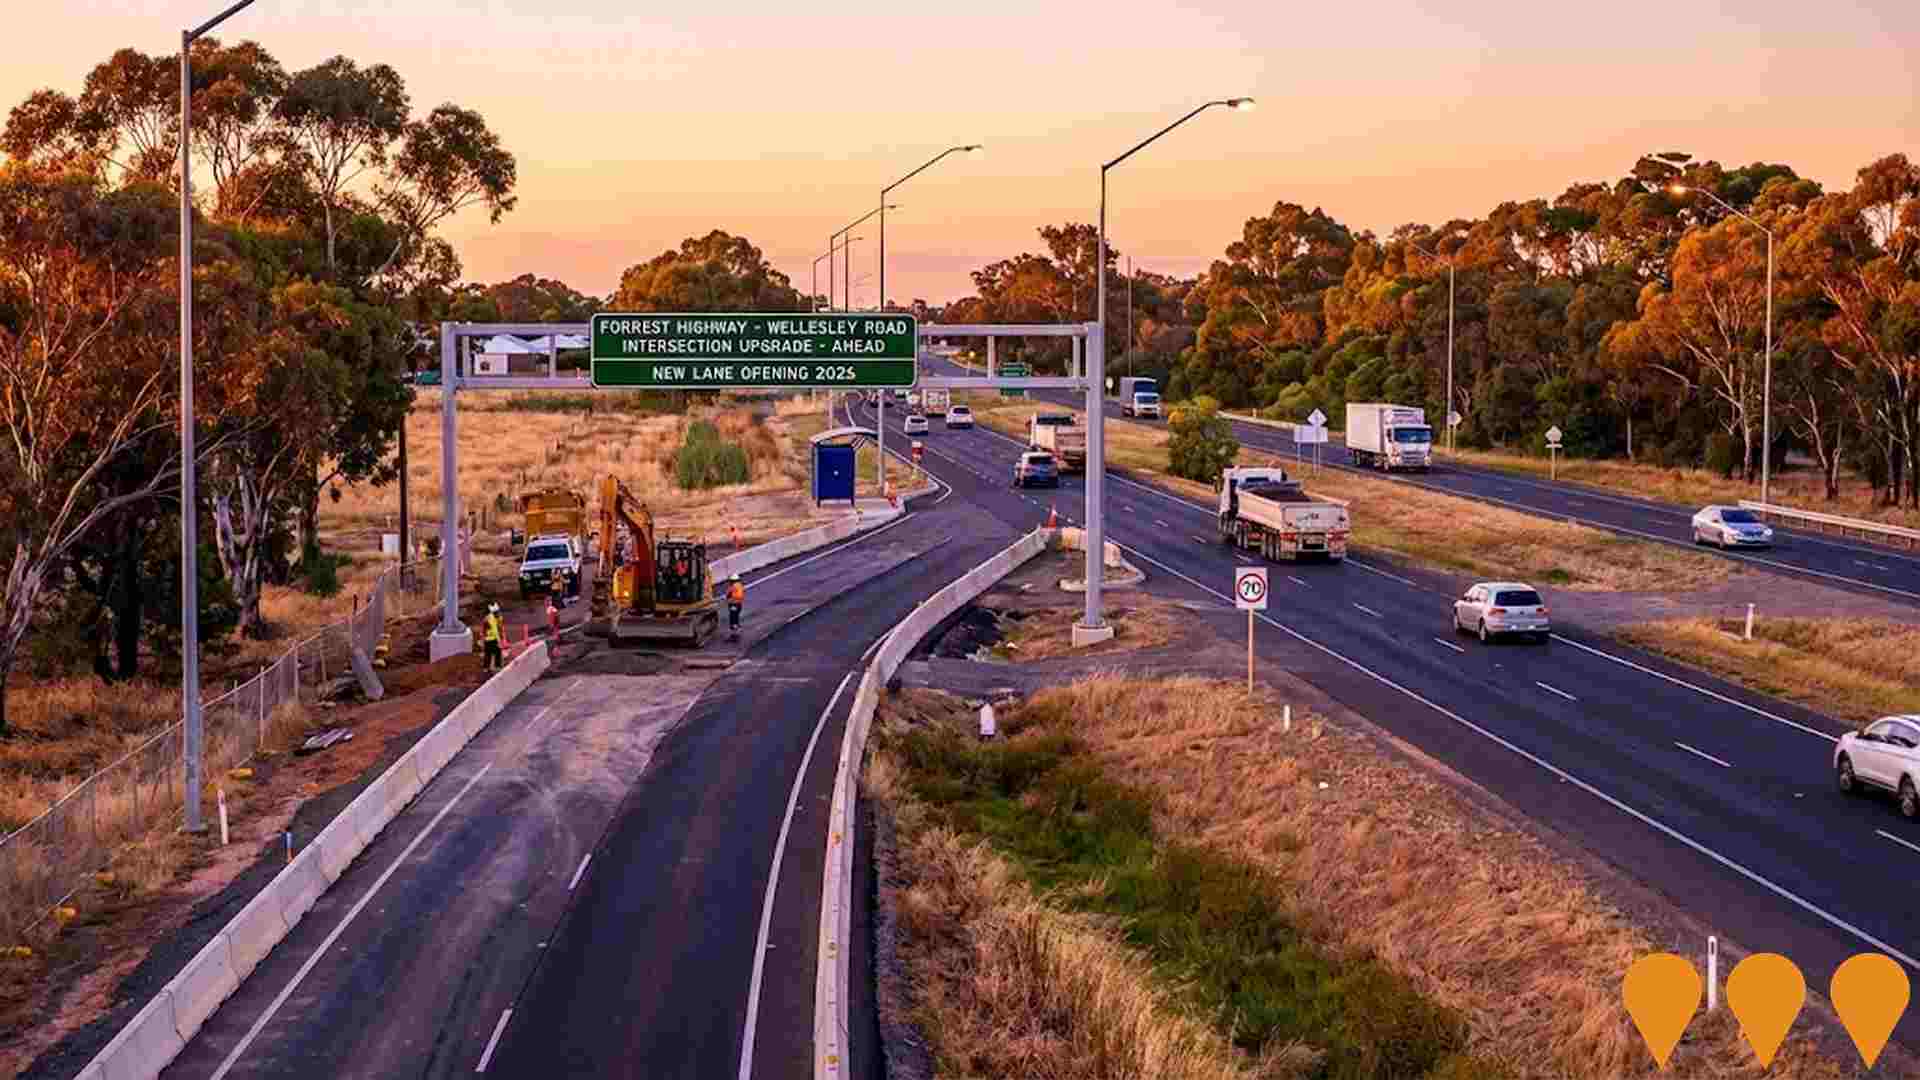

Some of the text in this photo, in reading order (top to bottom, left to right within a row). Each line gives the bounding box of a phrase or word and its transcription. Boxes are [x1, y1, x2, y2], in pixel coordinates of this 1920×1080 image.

[600, 320, 669, 334] FORREST
[676, 320, 747, 334] HIGHWAY
[767, 320, 857, 334] WELLESLEY
[865, 320, 907, 334] ROAD
[622, 339, 732, 353] INTERSECTION
[739, 339, 812, 353] UPGRADE
[832, 339, 885, 353] AHEAD
[652, 365, 686, 380] NEW
[692, 365, 734, 380] LANE
[740, 365, 809, 380] OPENING
[1243, 580, 1261, 596] 70
